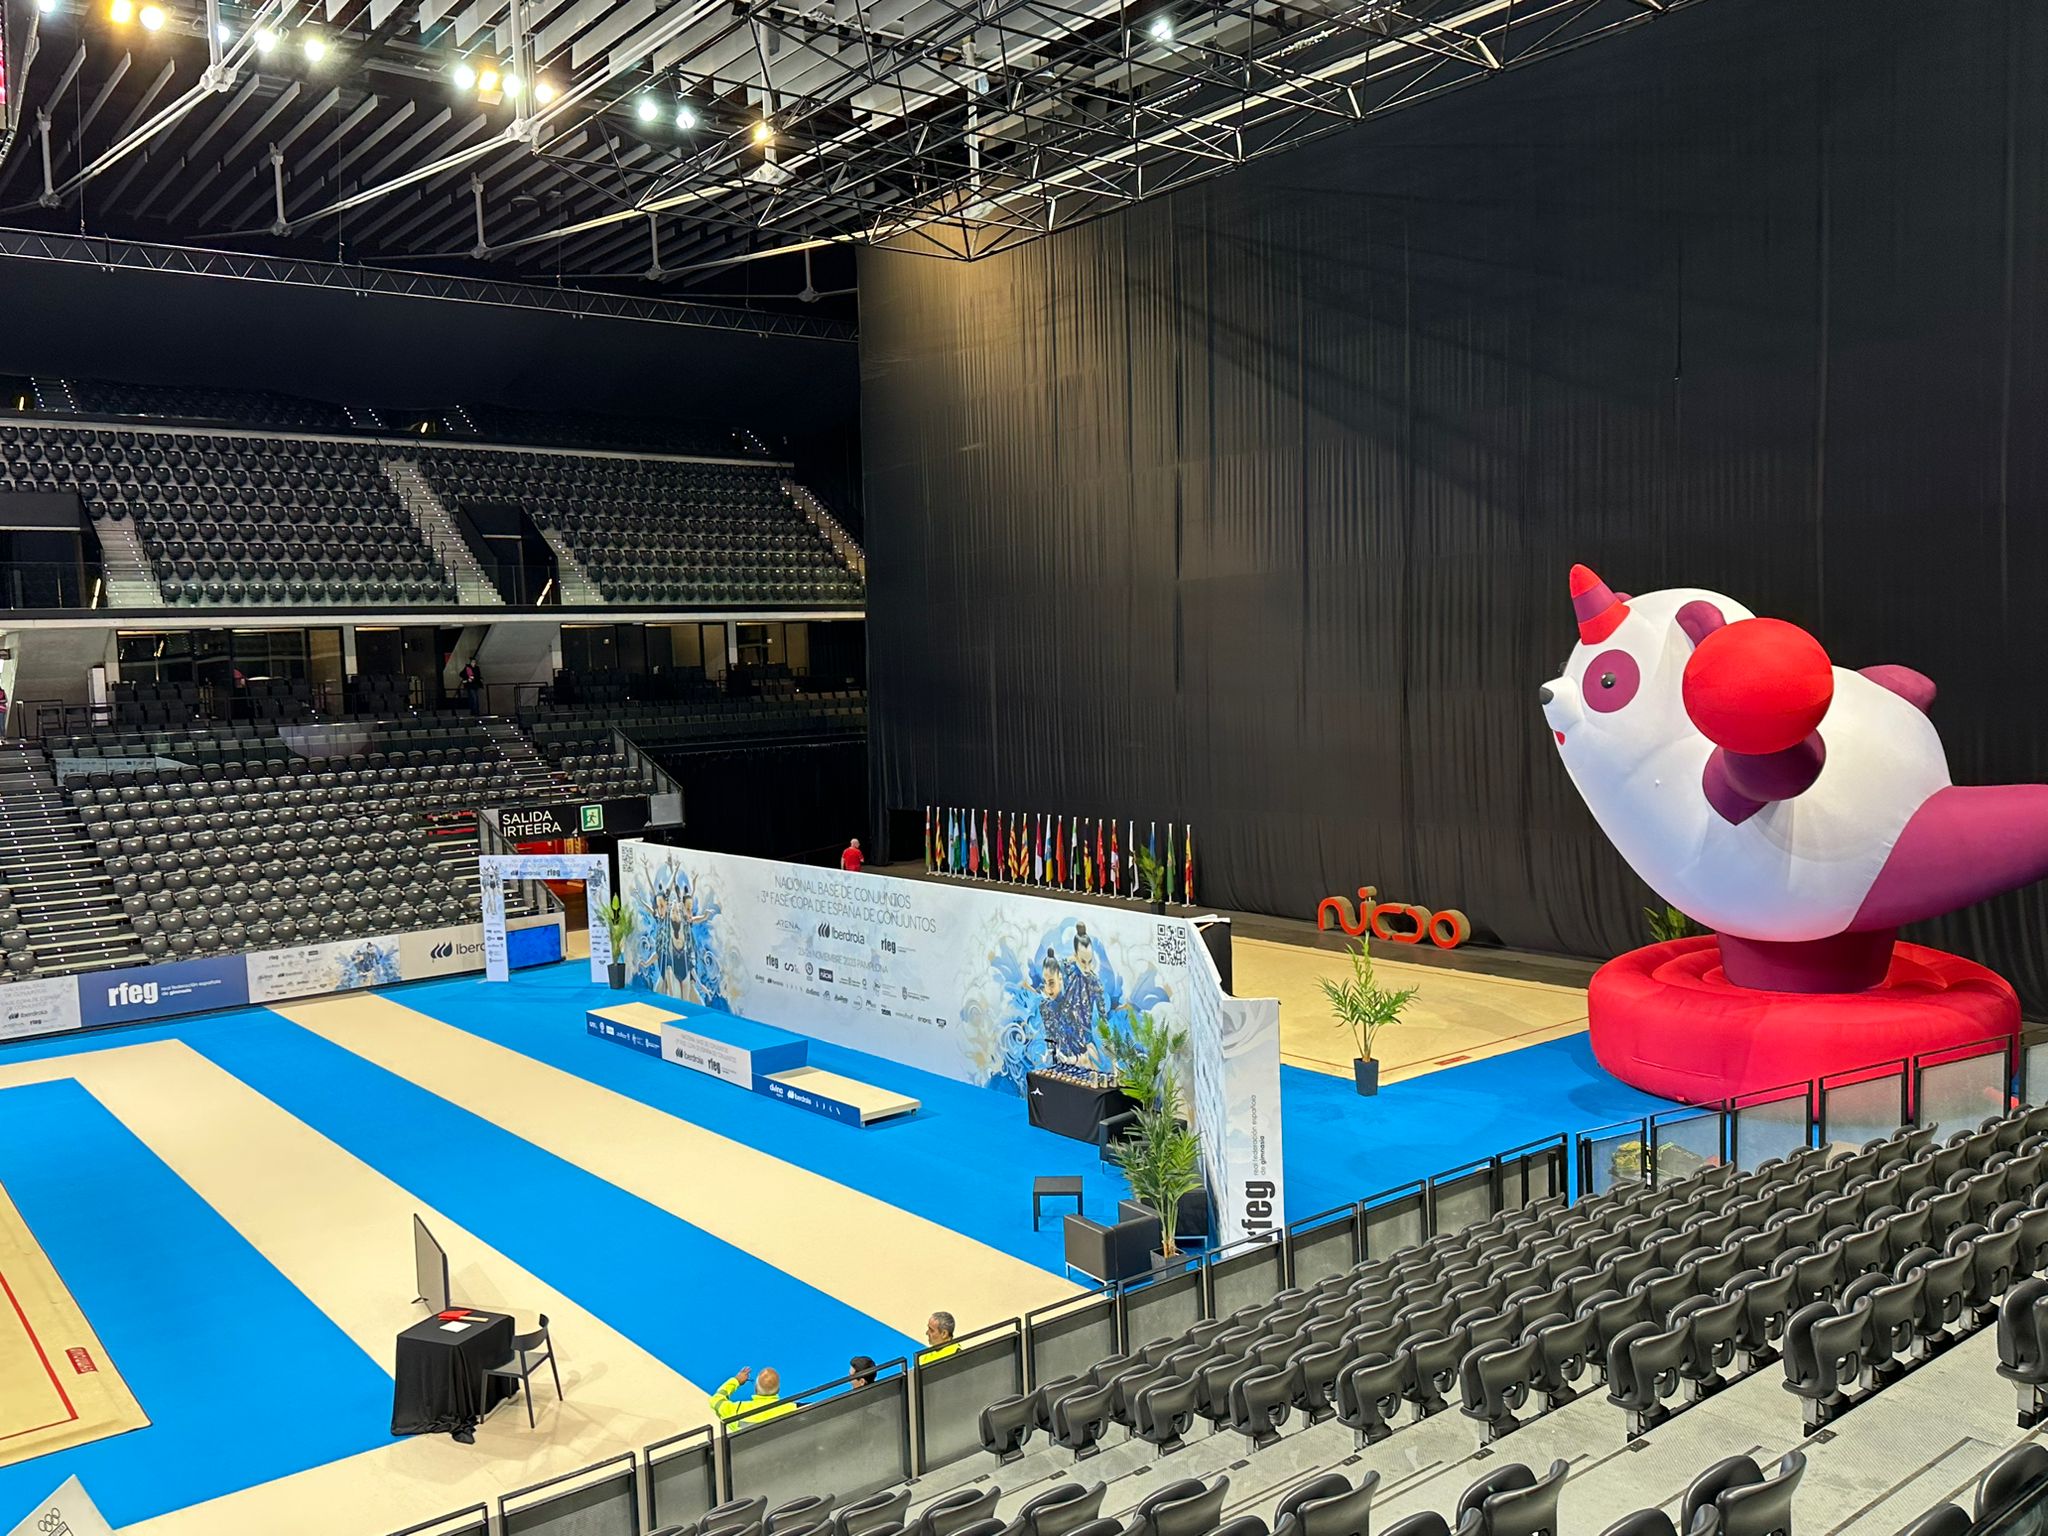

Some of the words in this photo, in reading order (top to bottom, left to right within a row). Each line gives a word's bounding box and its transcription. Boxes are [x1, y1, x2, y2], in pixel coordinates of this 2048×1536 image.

[502, 810, 553, 825] SALIDA
[503, 822, 562, 838] IRTEERA
[818, 881, 840, 898] BASE
[840, 884, 853, 900] DE
[854, 887, 912, 910] CONJUNTOS
[769, 891, 790, 908] FASE
[790, 895, 814, 912] COPA
[815, 898, 827, 914] DE
[827, 901, 862, 919] ESPAÑA
[863, 907, 876, 923] DE
[876, 909, 937, 934] CONJUNTOS
[832, 927, 865, 945] Iberdrola
[880, 938, 897, 955] rfeg
[766, 953, 779, 970] rfeg
[108, 982, 159, 1007] rfeg
[1259, 1135, 1267, 1165] gimnasia
